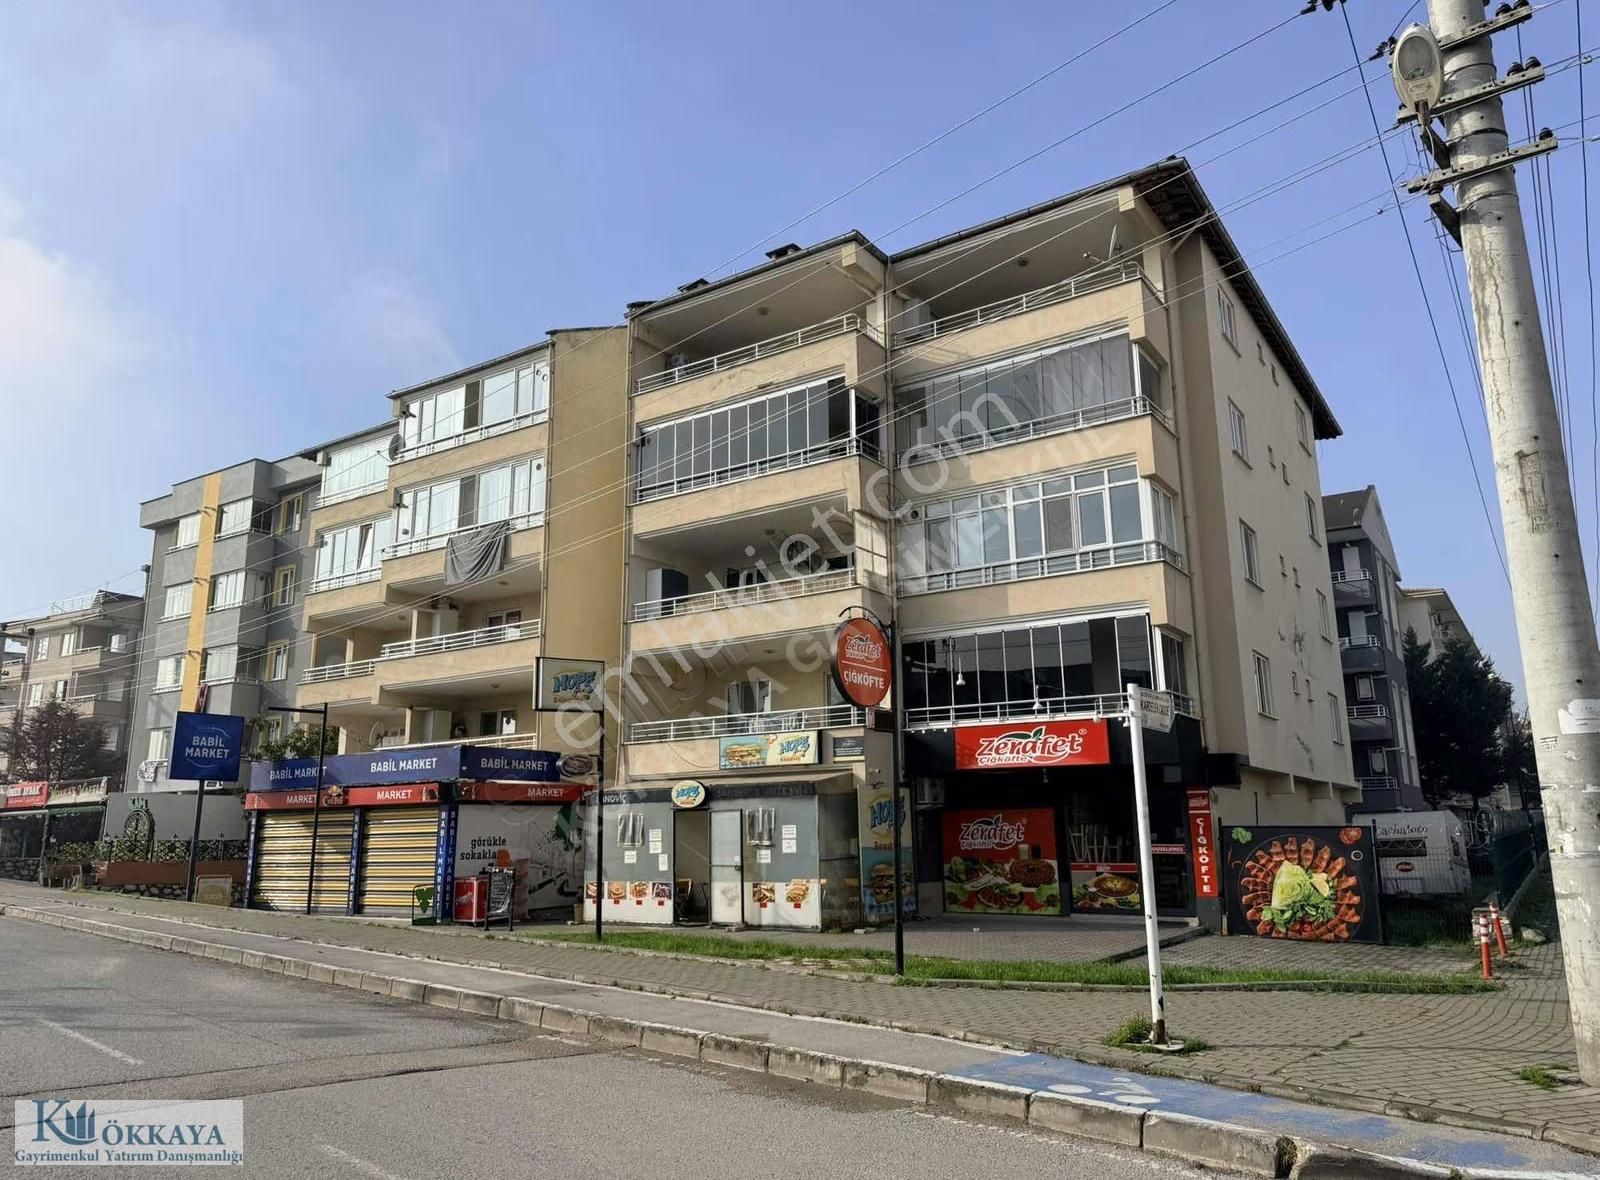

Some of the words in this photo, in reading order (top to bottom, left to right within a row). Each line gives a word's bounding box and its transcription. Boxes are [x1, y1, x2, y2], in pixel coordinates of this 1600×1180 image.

[192, 735, 224, 747] BABİL
[976, 732, 1084, 758] Zerafet
[185, 747, 230, 758] MARKET
[370, 758, 397, 773] BABİL
[399, 757, 438, 771] MARKET
[480, 757, 510, 769] BABİL
[512, 759, 549, 771] MARKET
[270, 767, 293, 780] BABİL
[376, 789, 412, 800] MARKET
[528, 787, 565, 797] MARKET
[286, 794, 317, 804] MARKET
[959, 821, 1025, 842] Zerafet
[460, 850, 499, 860] sokakla
